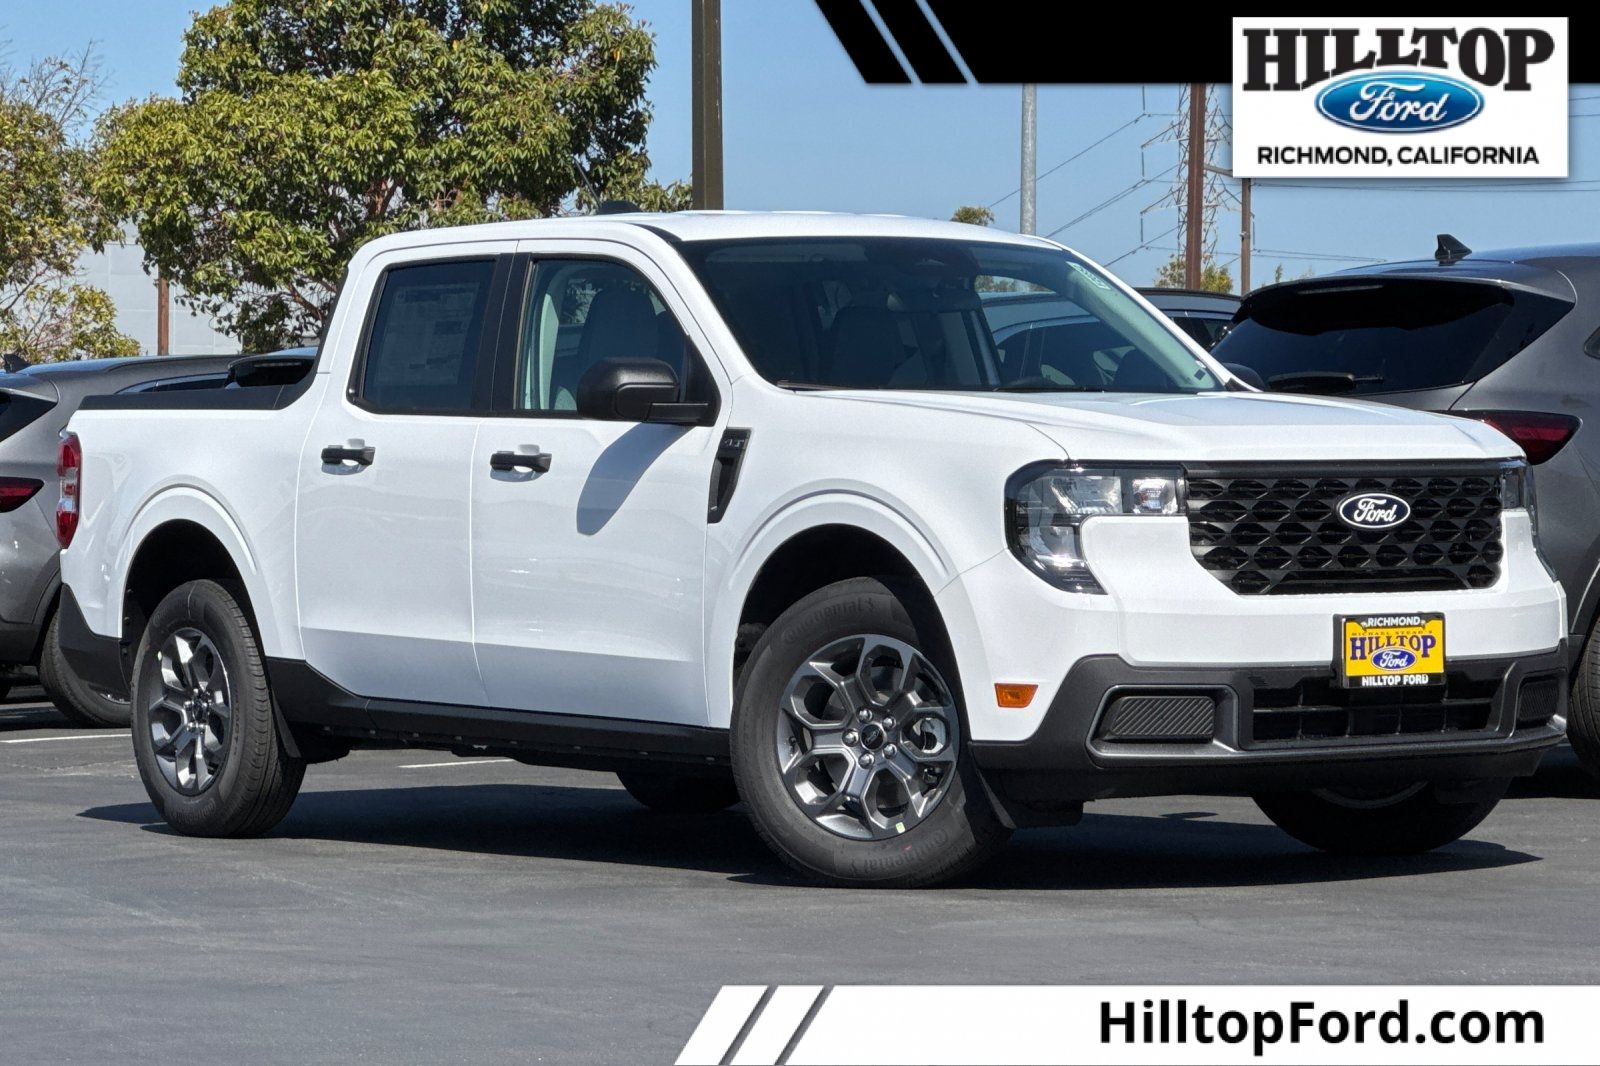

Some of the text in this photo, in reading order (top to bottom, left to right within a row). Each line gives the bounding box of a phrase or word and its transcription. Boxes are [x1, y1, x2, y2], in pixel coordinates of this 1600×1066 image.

[1354, 498, 1398, 522] Ford
[1367, 616, 1421, 627] RICHMOND
[1349, 634, 1437, 660] HILLTOP
[1380, 650, 1408, 667] Ford
[1361, 674, 1429, 687] HILLTOP FORD
